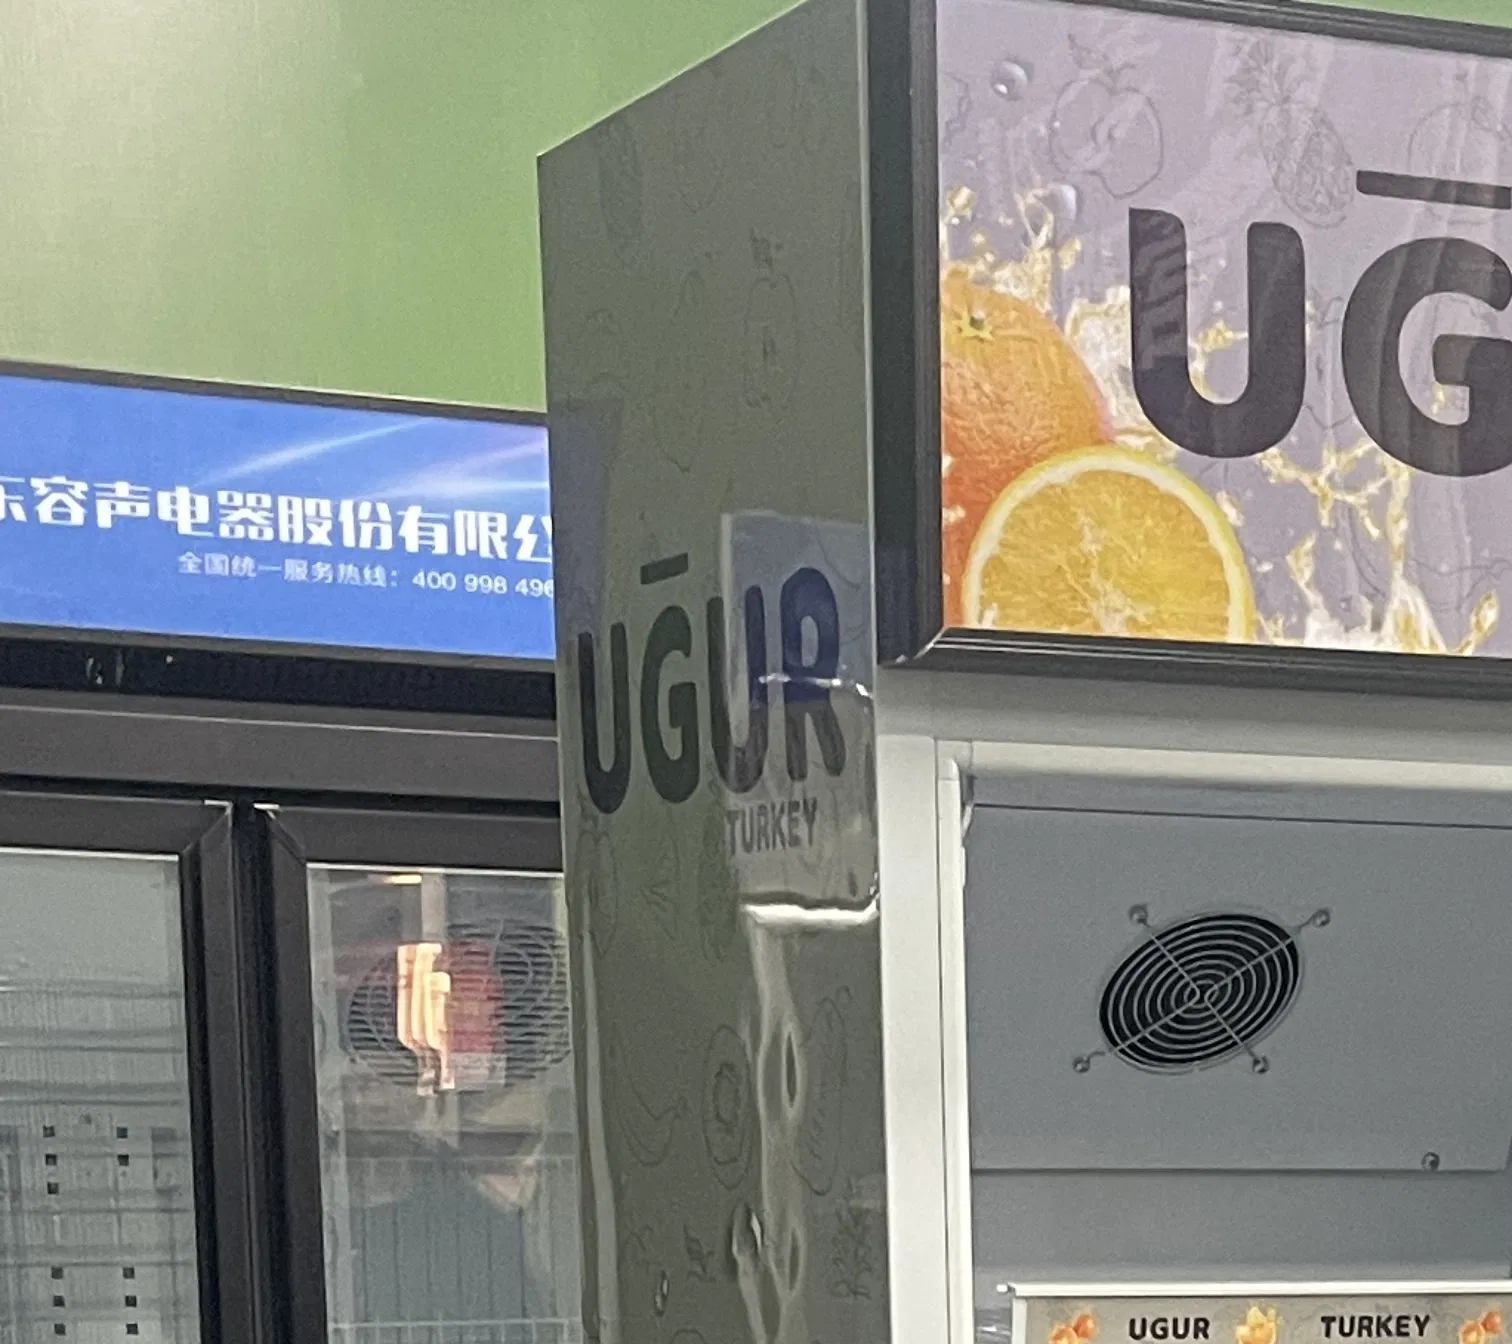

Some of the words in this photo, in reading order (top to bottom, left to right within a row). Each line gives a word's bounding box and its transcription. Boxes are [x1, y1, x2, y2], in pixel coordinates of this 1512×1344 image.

[412, 570, 457, 591] 400
[464, 573, 508, 595] 998
[726, 796, 818, 855] TURKEY
[1128, 1316, 1210, 1341] UGUR
[1320, 1314, 1431, 1339] TURKEY
